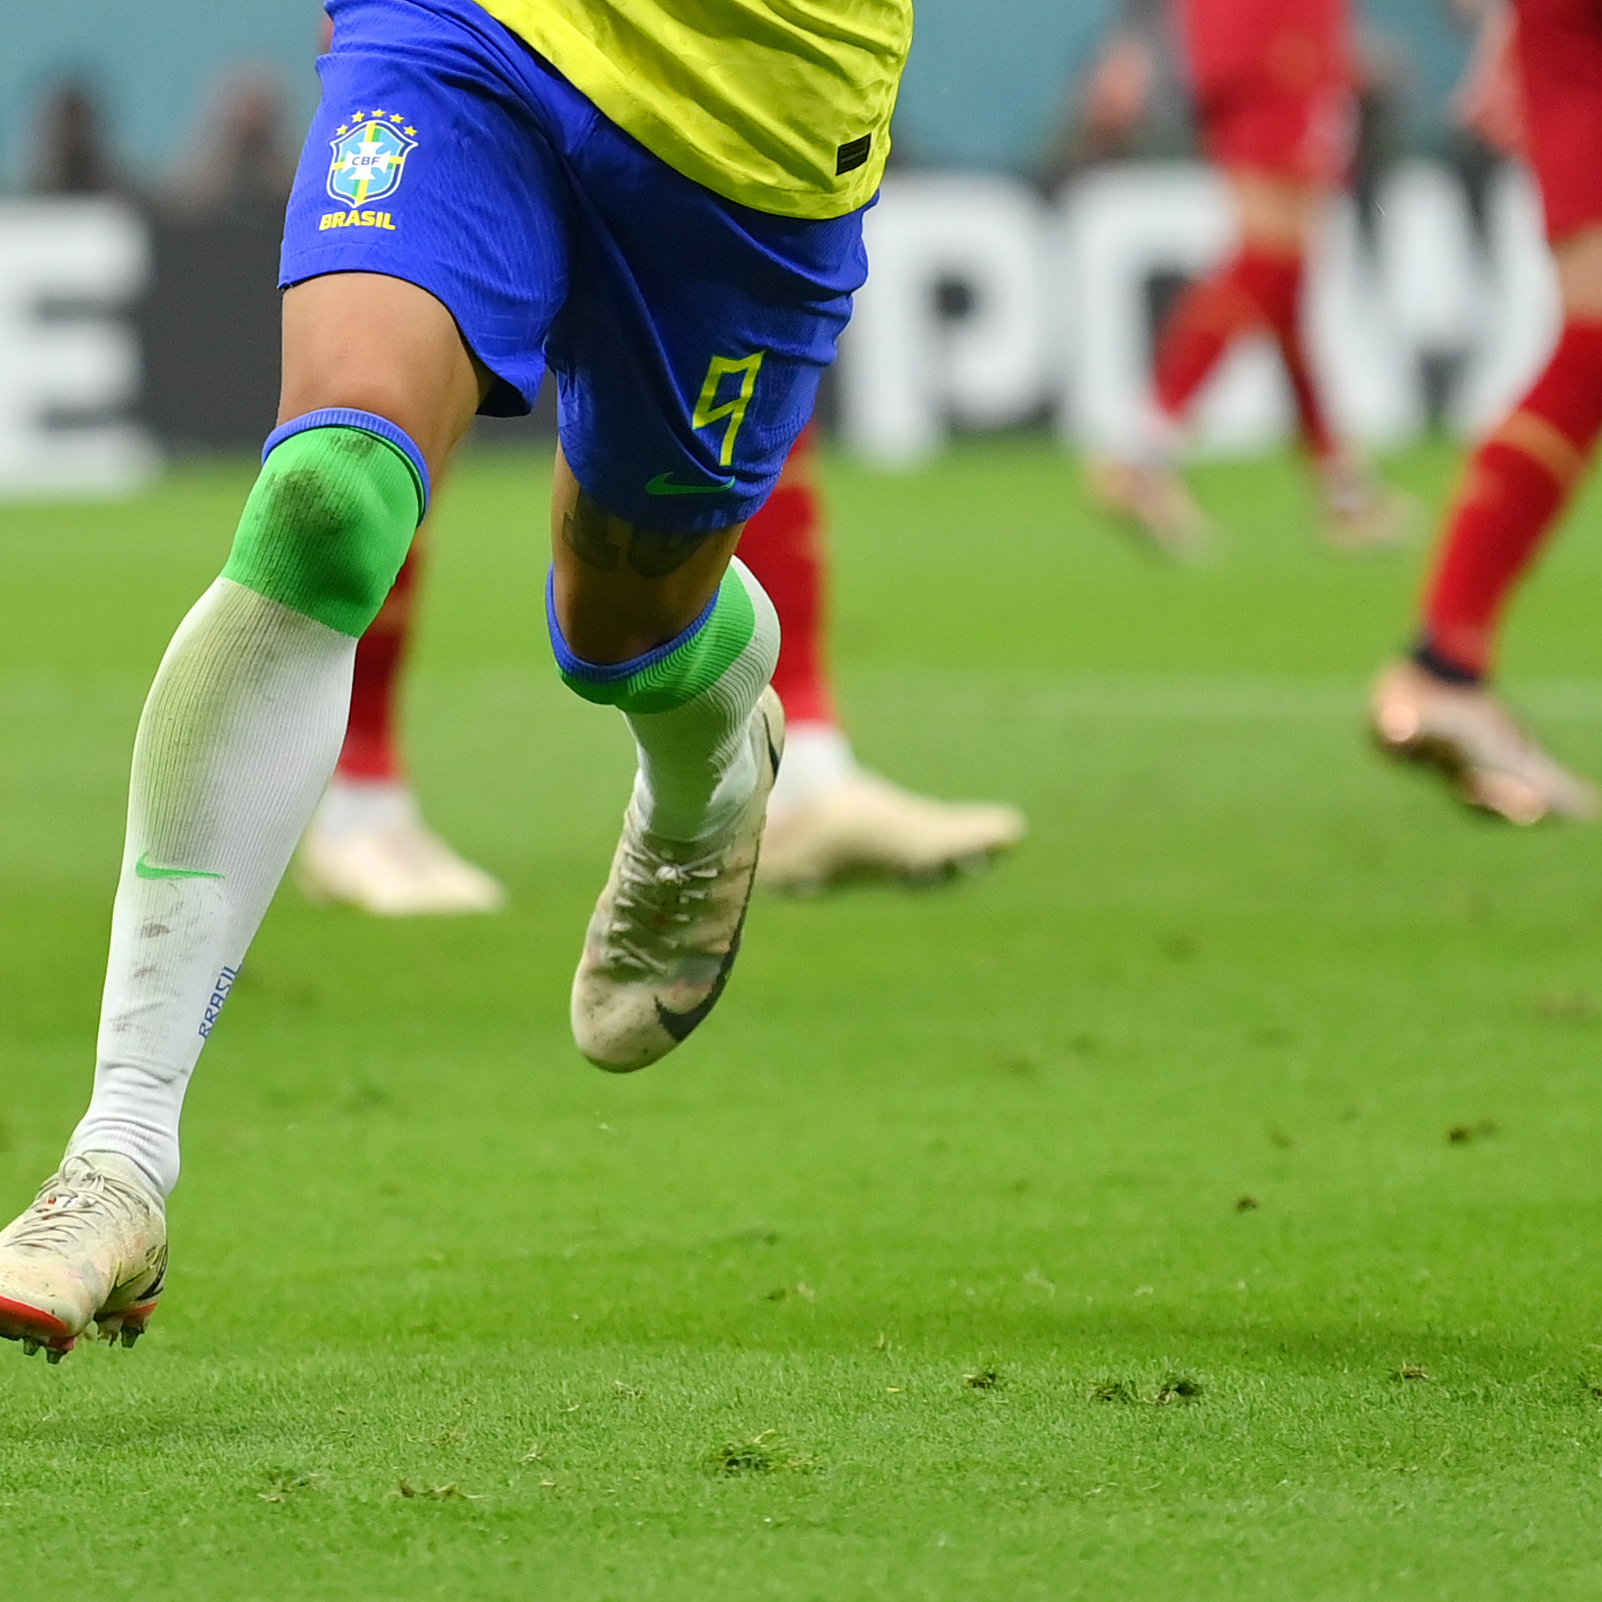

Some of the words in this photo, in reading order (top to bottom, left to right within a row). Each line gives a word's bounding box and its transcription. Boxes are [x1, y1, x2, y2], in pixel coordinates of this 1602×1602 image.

[351, 156, 382, 167] CBF
[318, 209, 397, 232] BRASIL
[692, 349, 766, 467] 9
